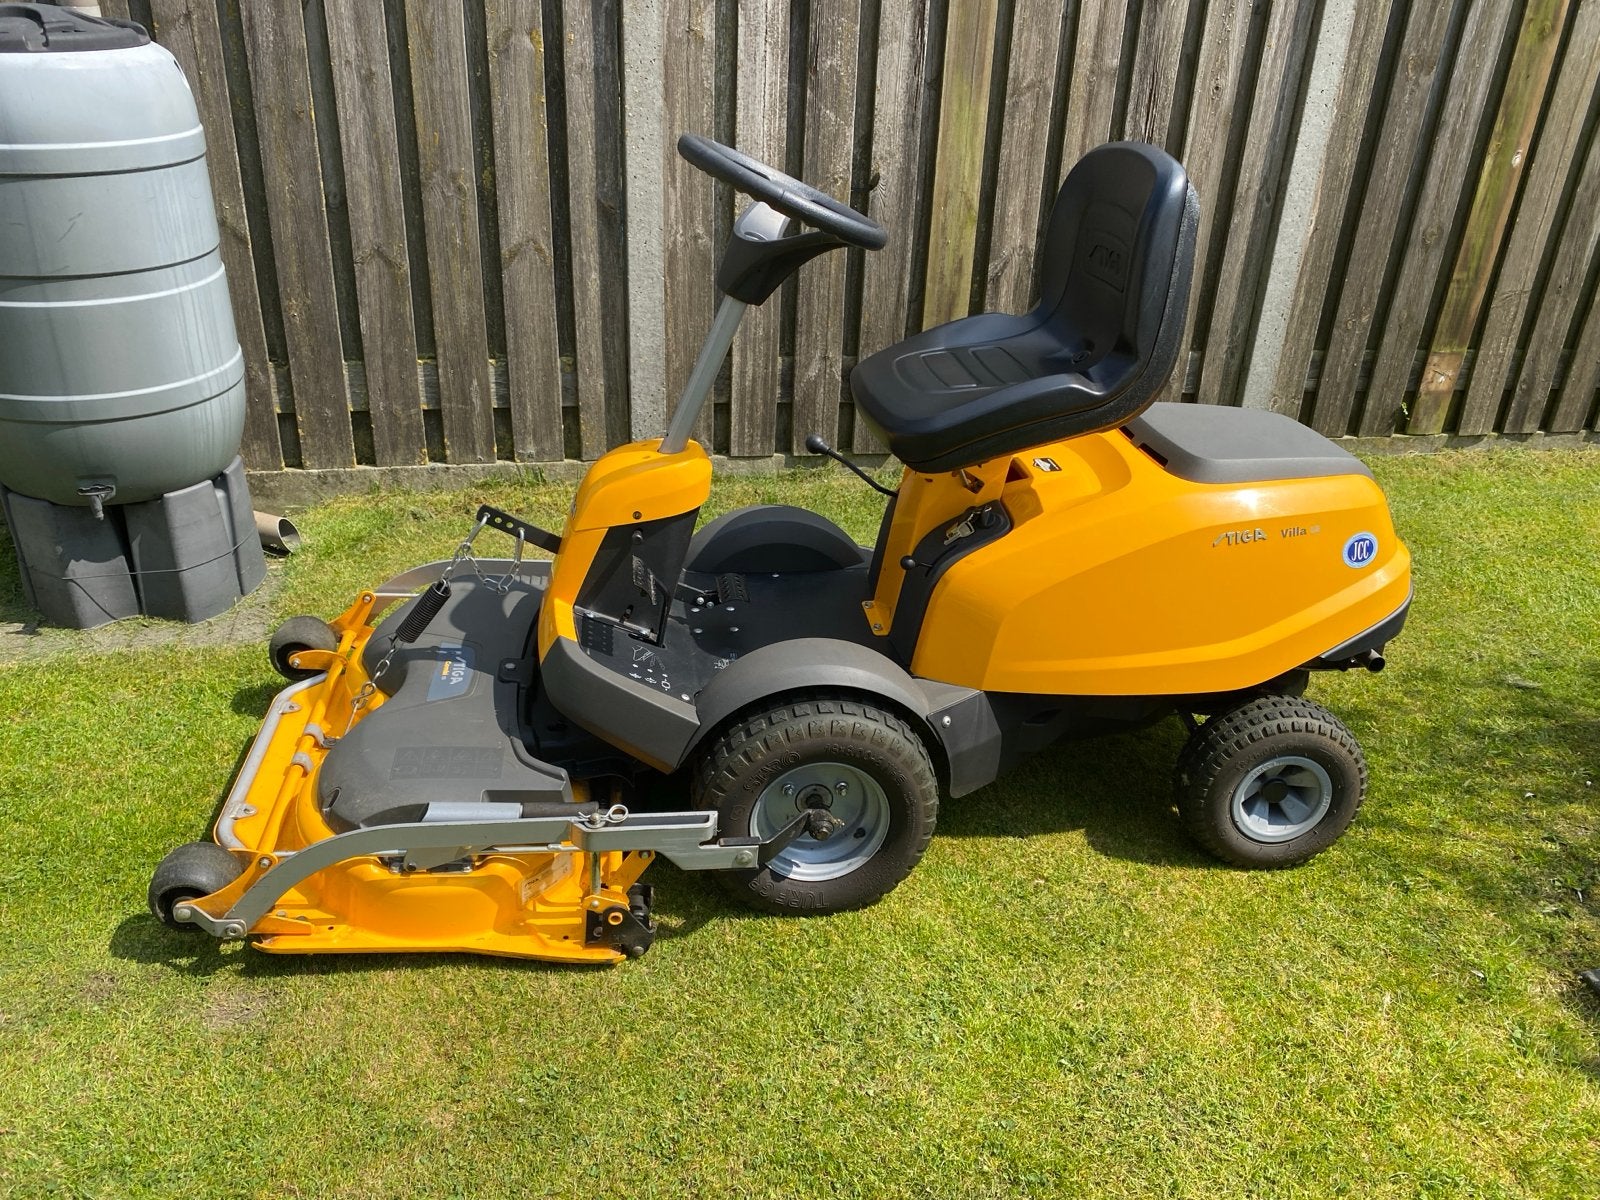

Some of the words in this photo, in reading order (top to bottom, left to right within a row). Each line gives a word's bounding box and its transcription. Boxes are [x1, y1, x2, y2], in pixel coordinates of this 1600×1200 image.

[1212, 527, 1267, 548] STIGA
[1280, 526, 1307, 539] Villa
[1351, 540, 1370, 562] JCC
[449, 656, 466, 685] STIGA
